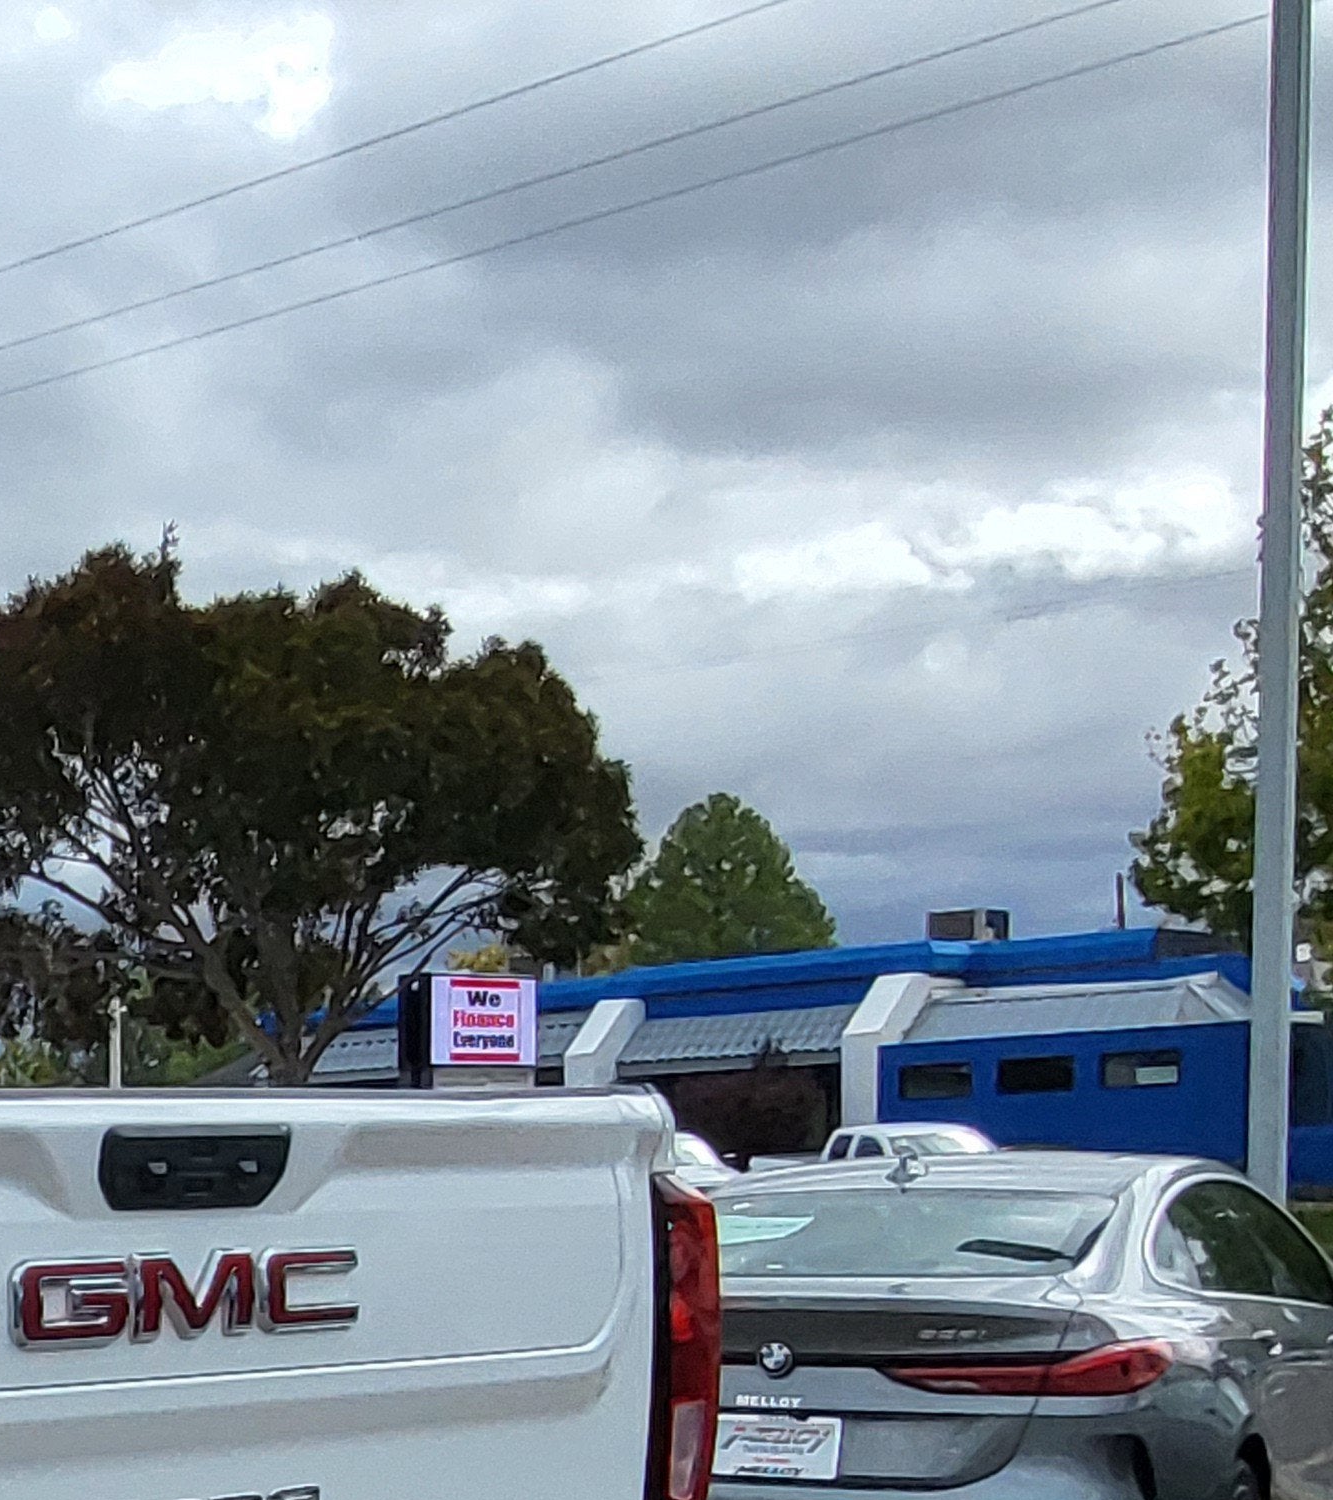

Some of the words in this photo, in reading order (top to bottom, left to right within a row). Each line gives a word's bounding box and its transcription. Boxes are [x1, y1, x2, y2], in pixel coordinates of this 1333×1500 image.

[466, 990, 502, 1007] We
[7, 1246, 360, 1352] GMC
[735, 1394, 802, 1408] MELLOY
